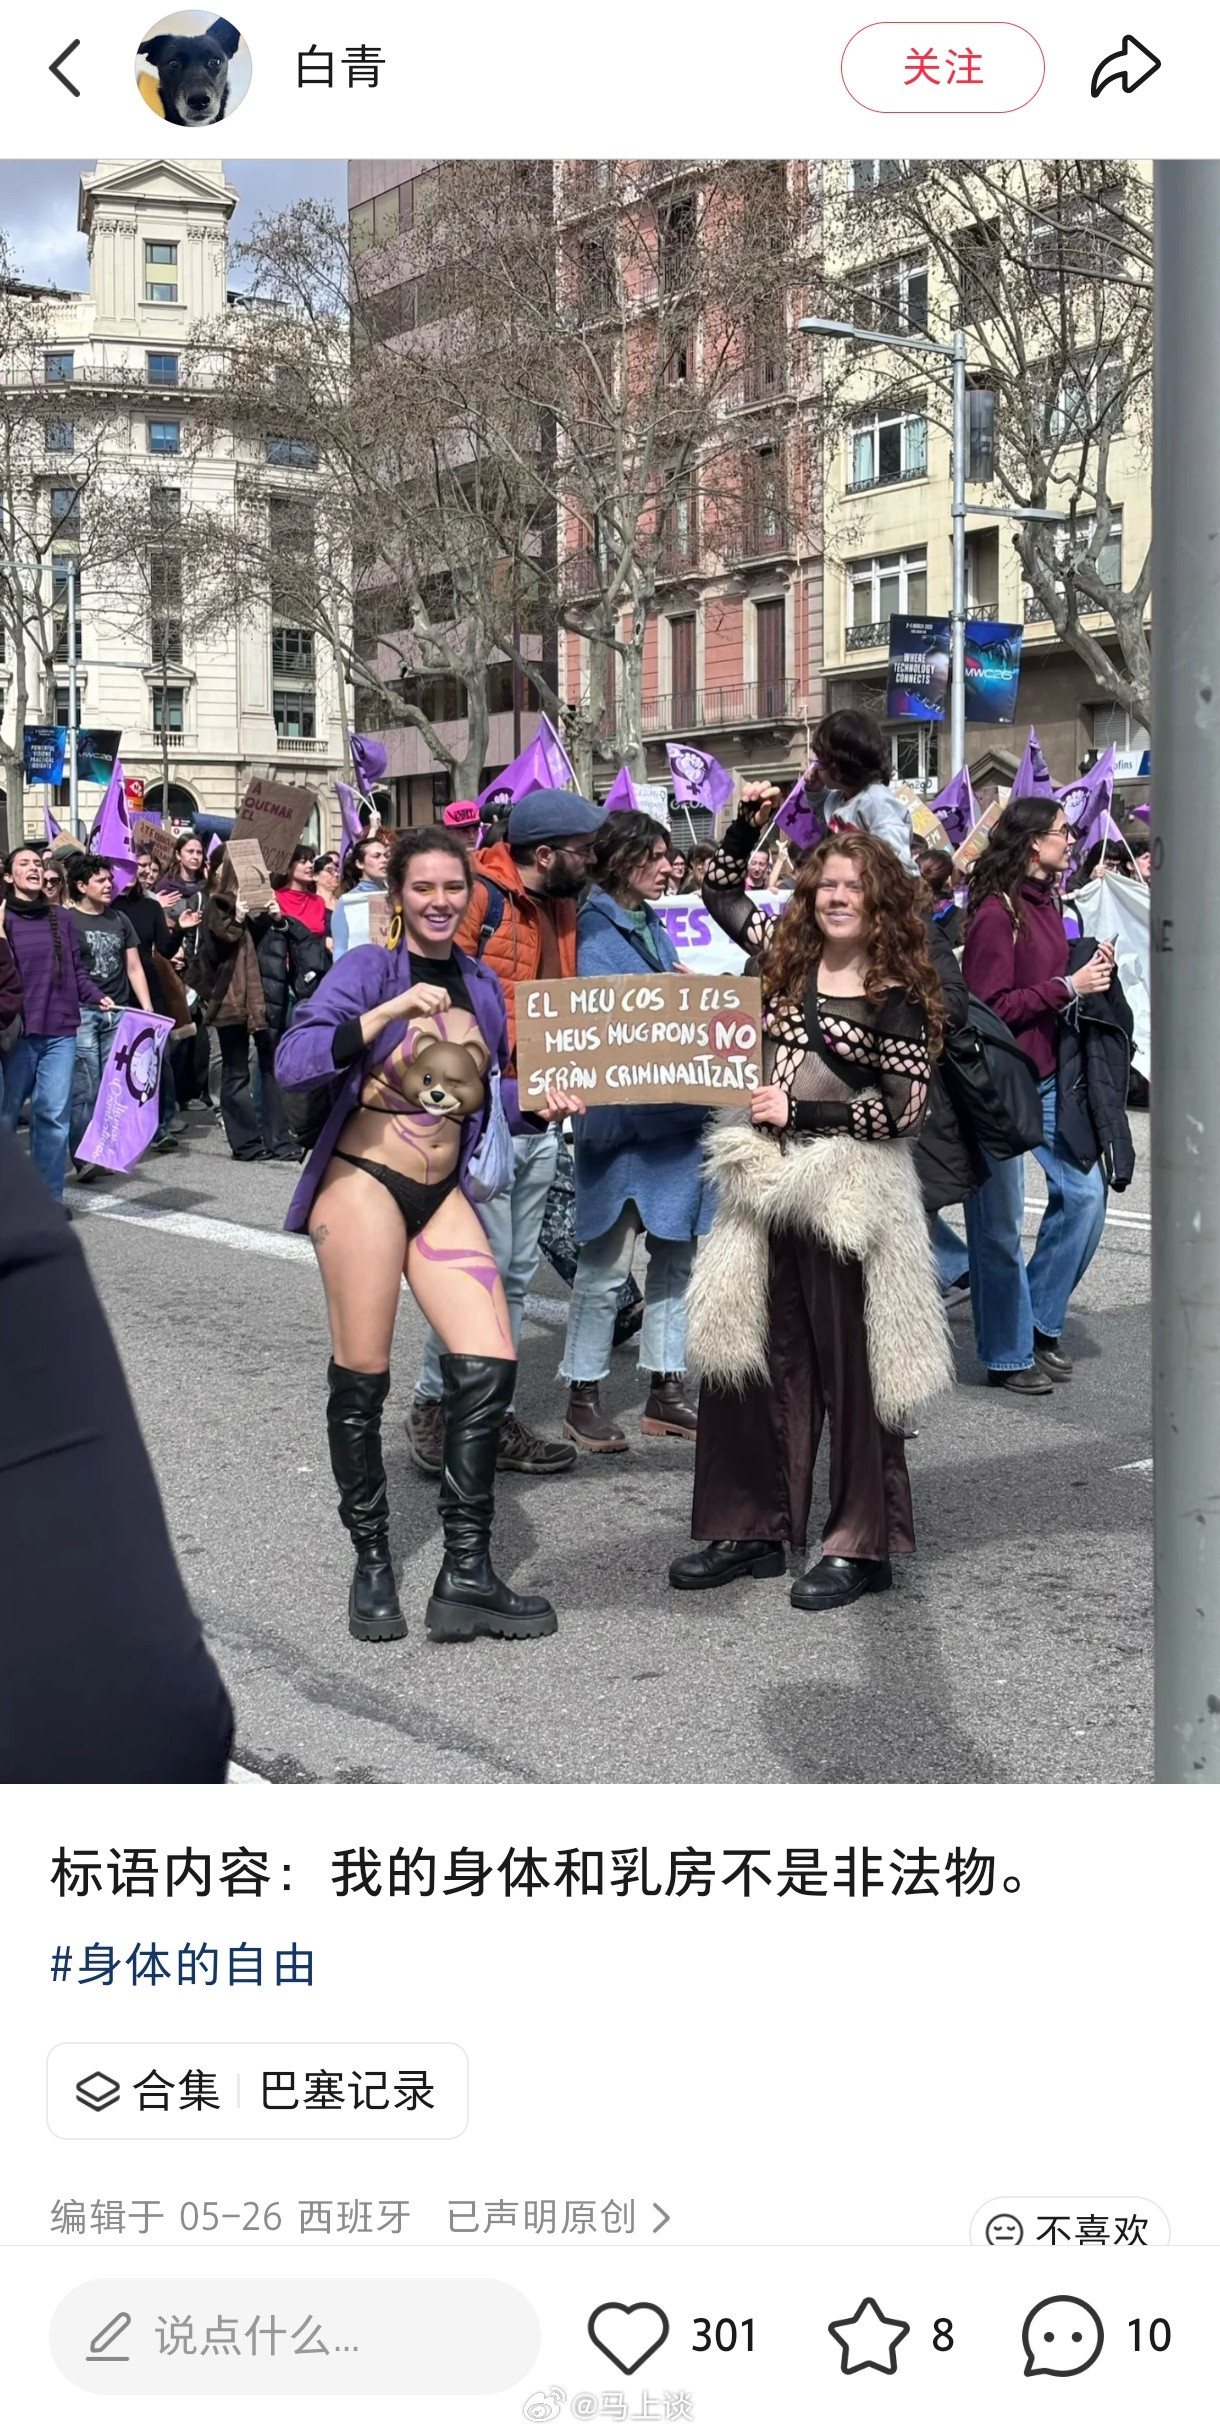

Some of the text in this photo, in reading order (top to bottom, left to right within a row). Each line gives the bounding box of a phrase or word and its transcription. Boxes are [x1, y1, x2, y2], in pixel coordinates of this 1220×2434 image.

[903, 653, 926, 663] WHERE
[894, 662, 936, 675] TECHNOLOGY
[964, 667, 1013, 680] MWC26
[895, 673, 931, 685] CONNECTS
[79, 752, 113, 762] MWC26
[252, 783, 262, 796] A
[241, 808, 255, 821] EL
[245, 797, 294, 820] QUEMAR
[527, 987, 740, 1018] EL MEU COS I ELS
[545, 1020, 757, 1053] MEUS MUGRONS NO
[526, 1055, 760, 1096] SERÀN CRIMINALITZATS
